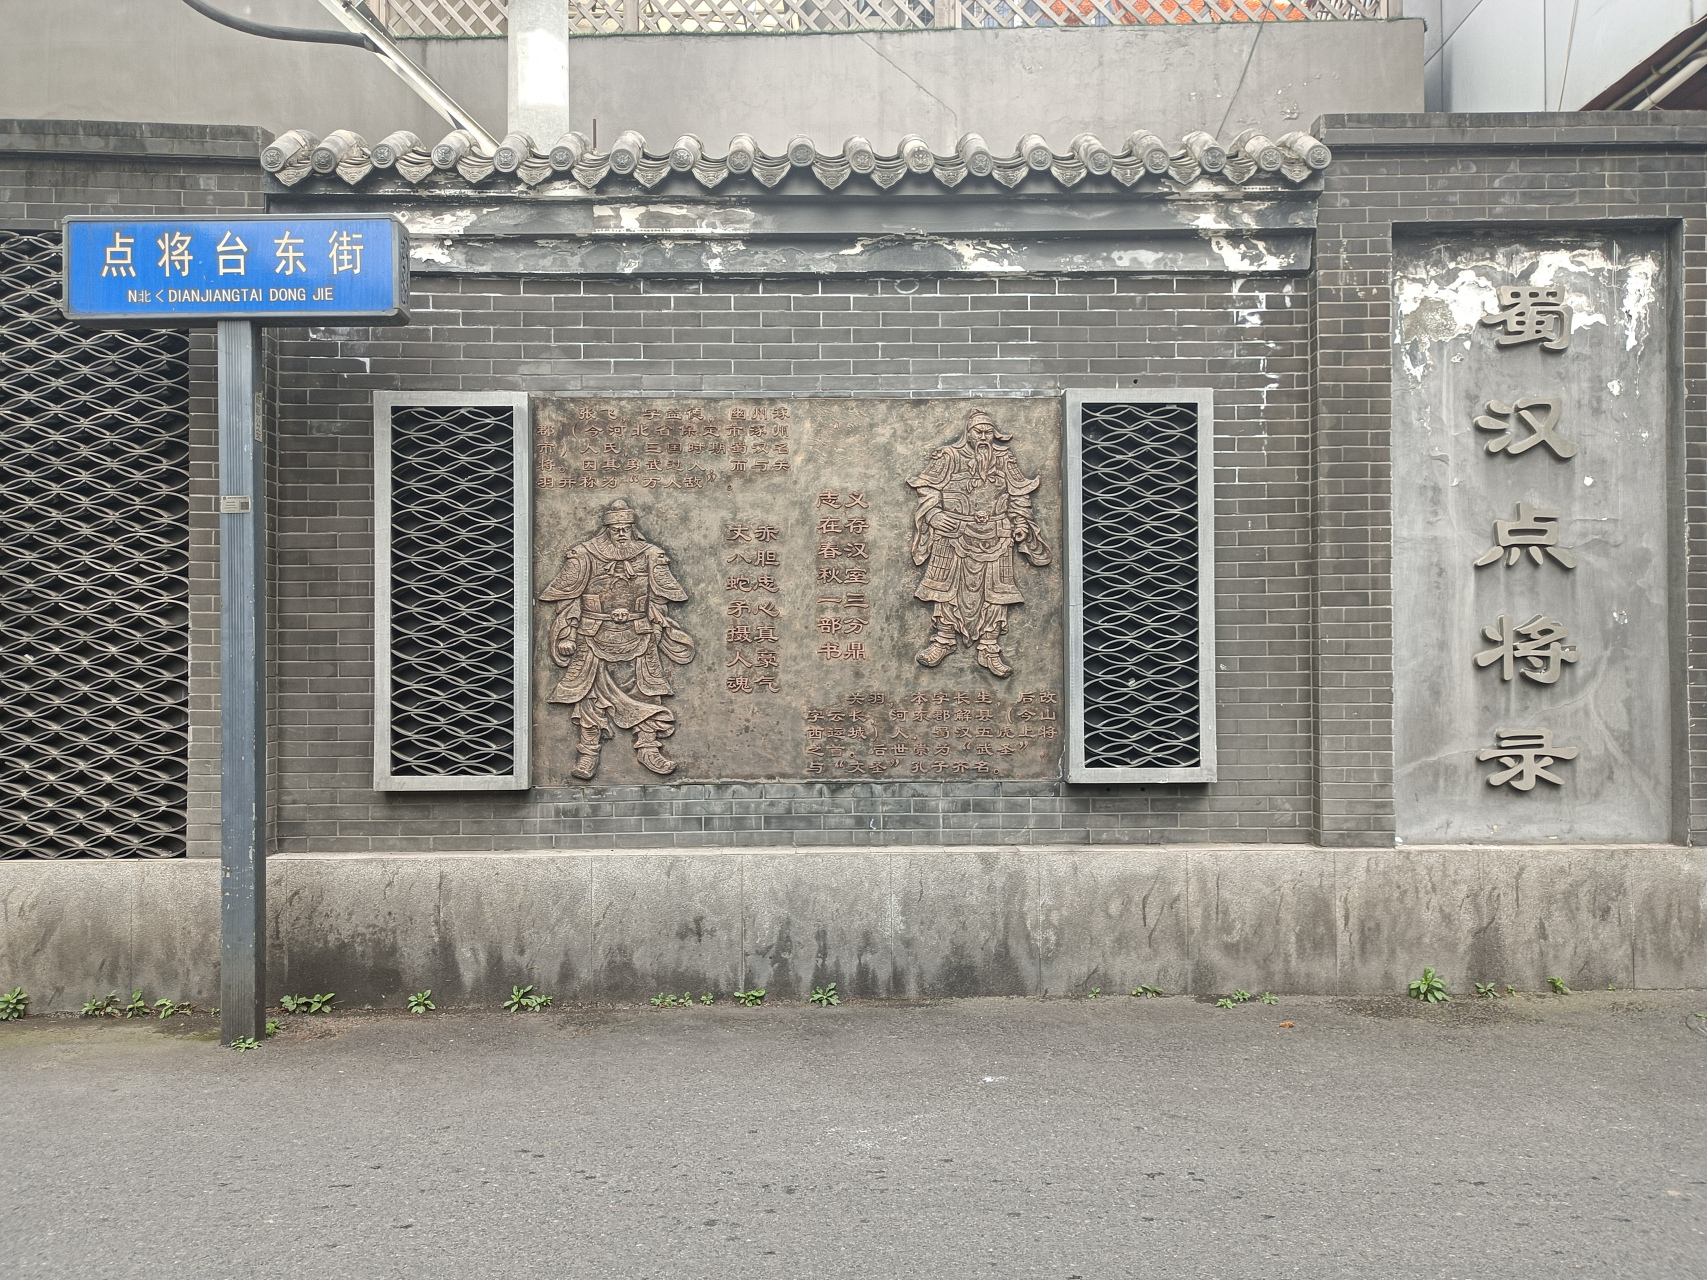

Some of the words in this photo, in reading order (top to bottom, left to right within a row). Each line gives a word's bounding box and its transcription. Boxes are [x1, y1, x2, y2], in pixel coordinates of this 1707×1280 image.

[101, 230, 364, 278] 点将台东街
[168, 288, 263, 303] DIANJIANGTAI
[269, 287, 306, 302] DONG
[312, 287, 334, 301] JIE
[725, 524, 753, 694] 丈八蛇矛摄人魂
[753, 524, 781, 694] 赤胆忠心真豪气
[815, 490, 843, 660] 志在春秋一部书
[842, 490, 870, 661] 义存汉室三分鼎
[1473, 284, 1581, 791] 蜀汉点将录
